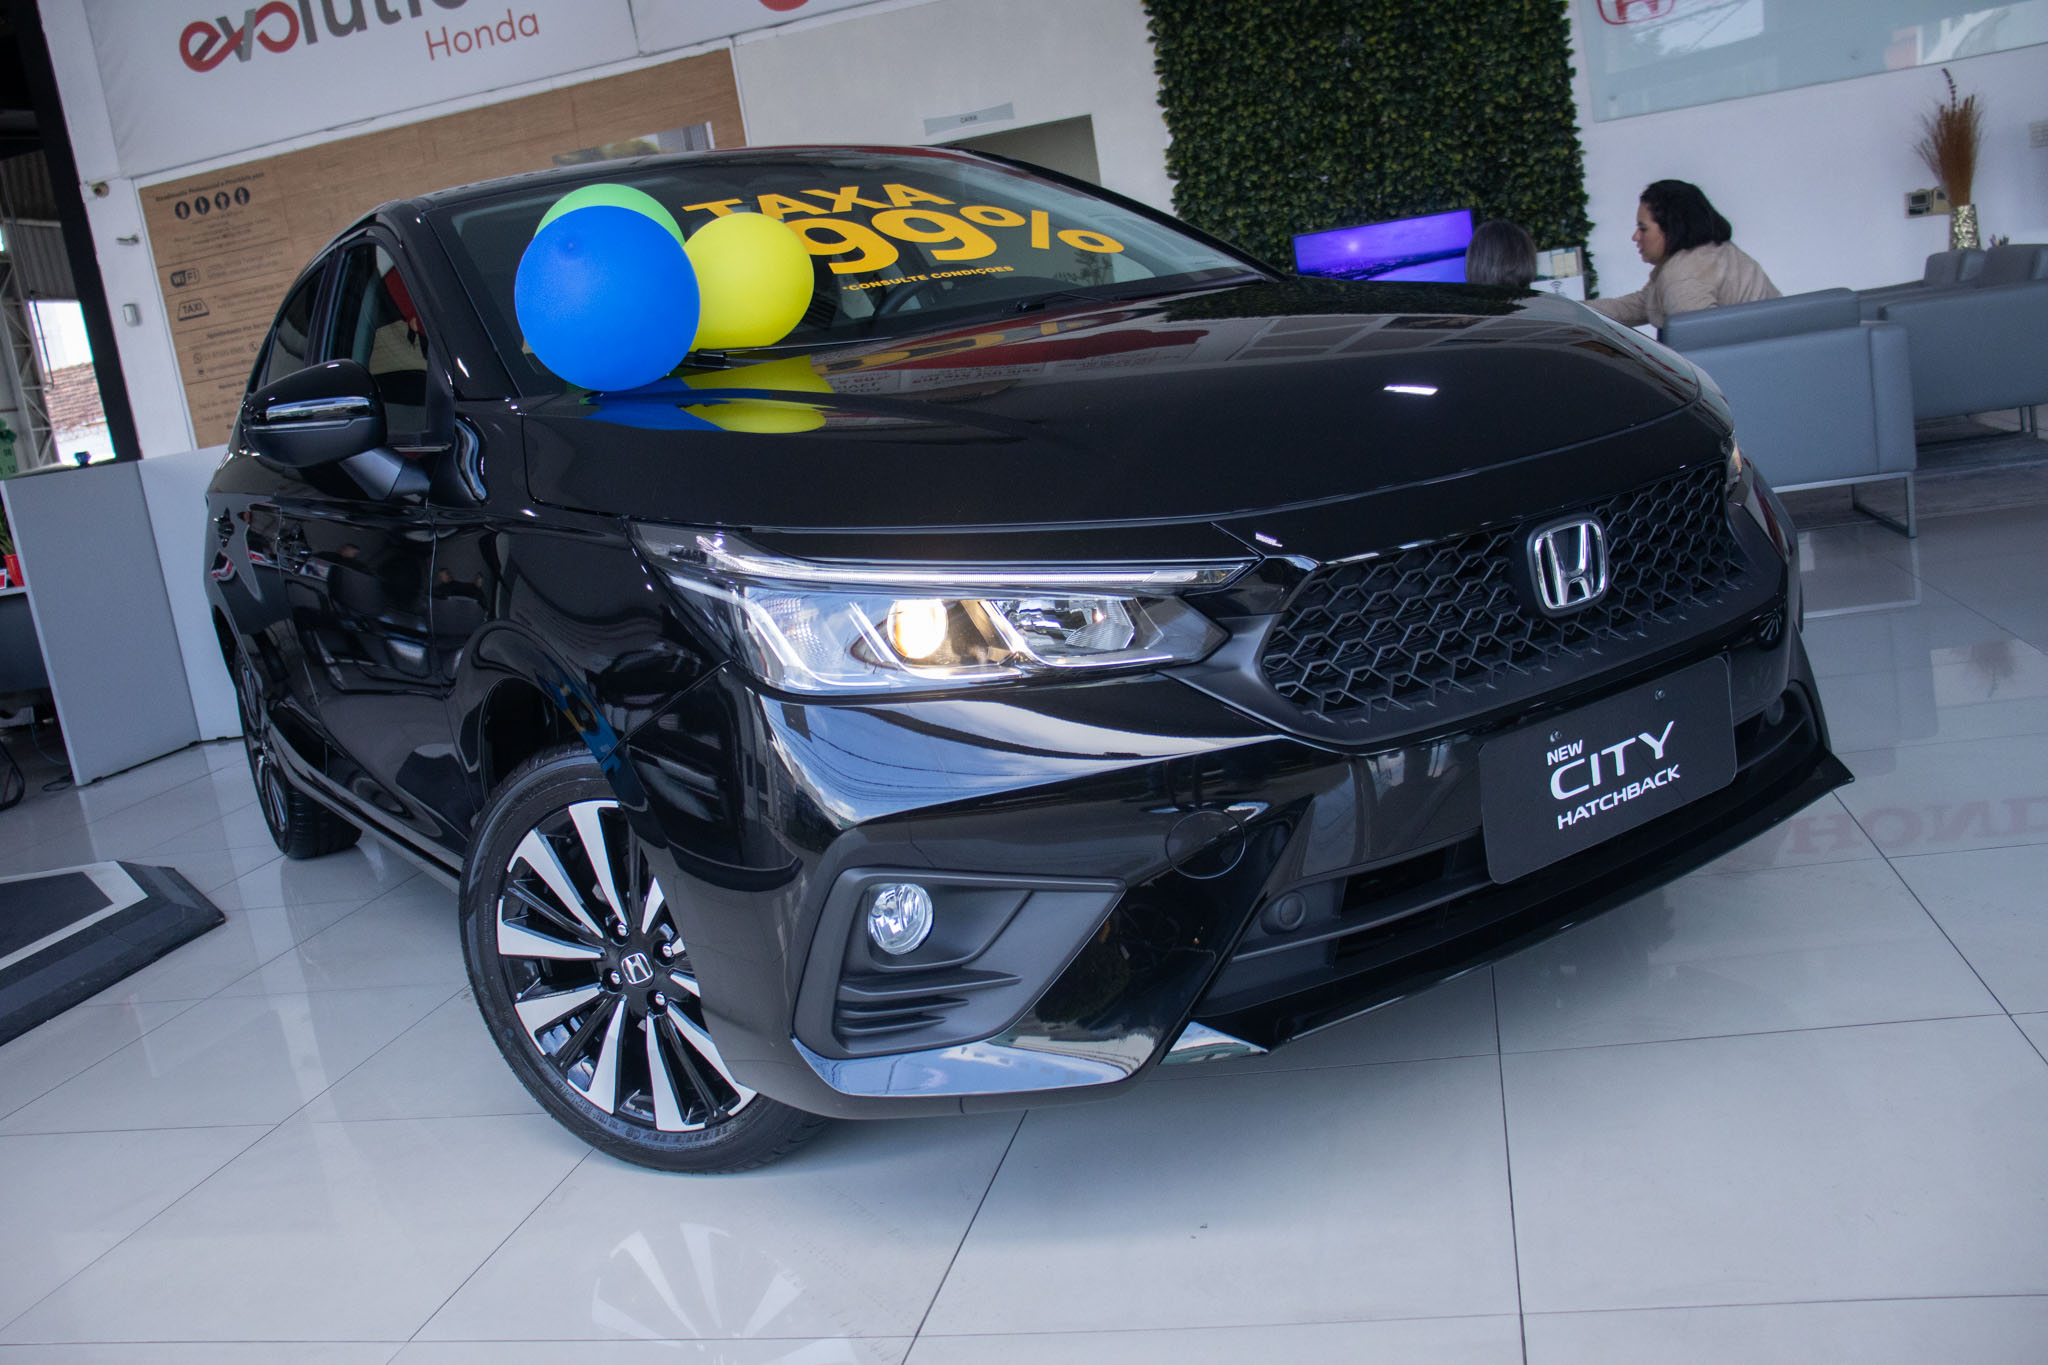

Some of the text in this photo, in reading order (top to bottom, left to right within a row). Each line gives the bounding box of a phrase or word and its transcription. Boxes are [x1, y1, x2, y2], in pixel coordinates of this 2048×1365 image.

[424, 8, 541, 61] Honda
[681, 184, 956, 219] TAXA
[182, 302, 202, 315] TAXI
[1546, 739, 1583, 766] NEW
[1550, 720, 1675, 800] CITY
[1557, 763, 1681, 831] HATCHBACK
